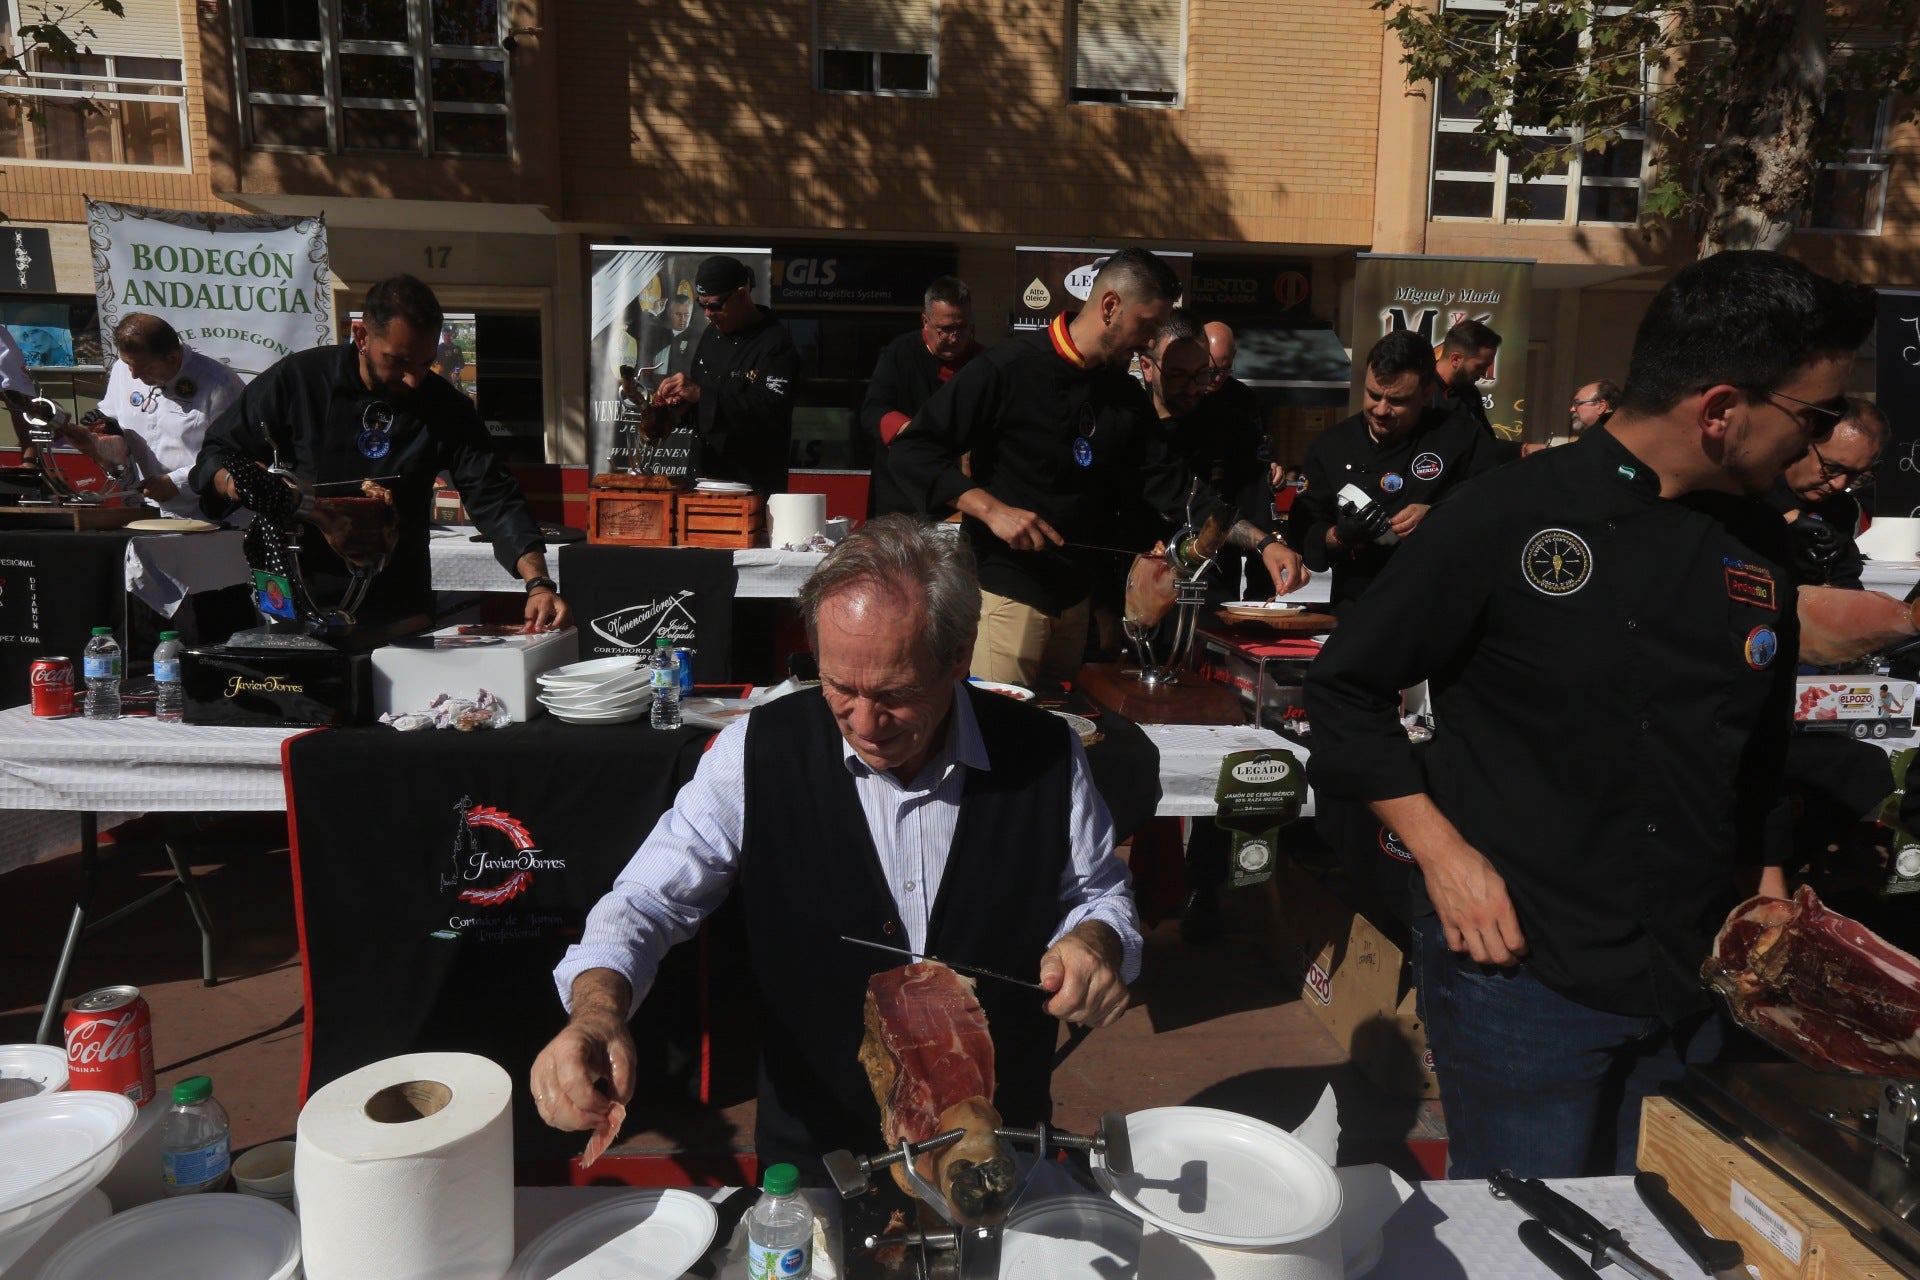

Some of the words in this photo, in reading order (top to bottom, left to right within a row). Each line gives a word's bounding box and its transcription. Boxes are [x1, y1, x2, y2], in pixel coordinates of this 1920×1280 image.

[131, 243, 295, 279] BODEGÓN
[425, 246, 453, 268] 17
[786, 258, 837, 285] GLS
[121, 279, 312, 314] ANDALUCÍA
[782, 288, 816, 298] General
[818, 288, 855, 300] Logistics
[857, 289, 892, 301] Systems
[1029, 288, 1045, 296] Alto
[1395, 286, 1444, 304] Miguel
[1444, 292, 1455, 305] y
[1458, 288, 1500, 304] María
[31, 593, 39, 630] JAMON
[608, 597, 673, 637] Venenciadores
[667, 618, 689, 631] Jesús
[657, 626, 696, 642] Delgado
[593, 646, 651, 654] CORTADORES
[1236, 765, 1285, 775] LEGADO
[1224, 790, 1246, 799] JAMÓN
